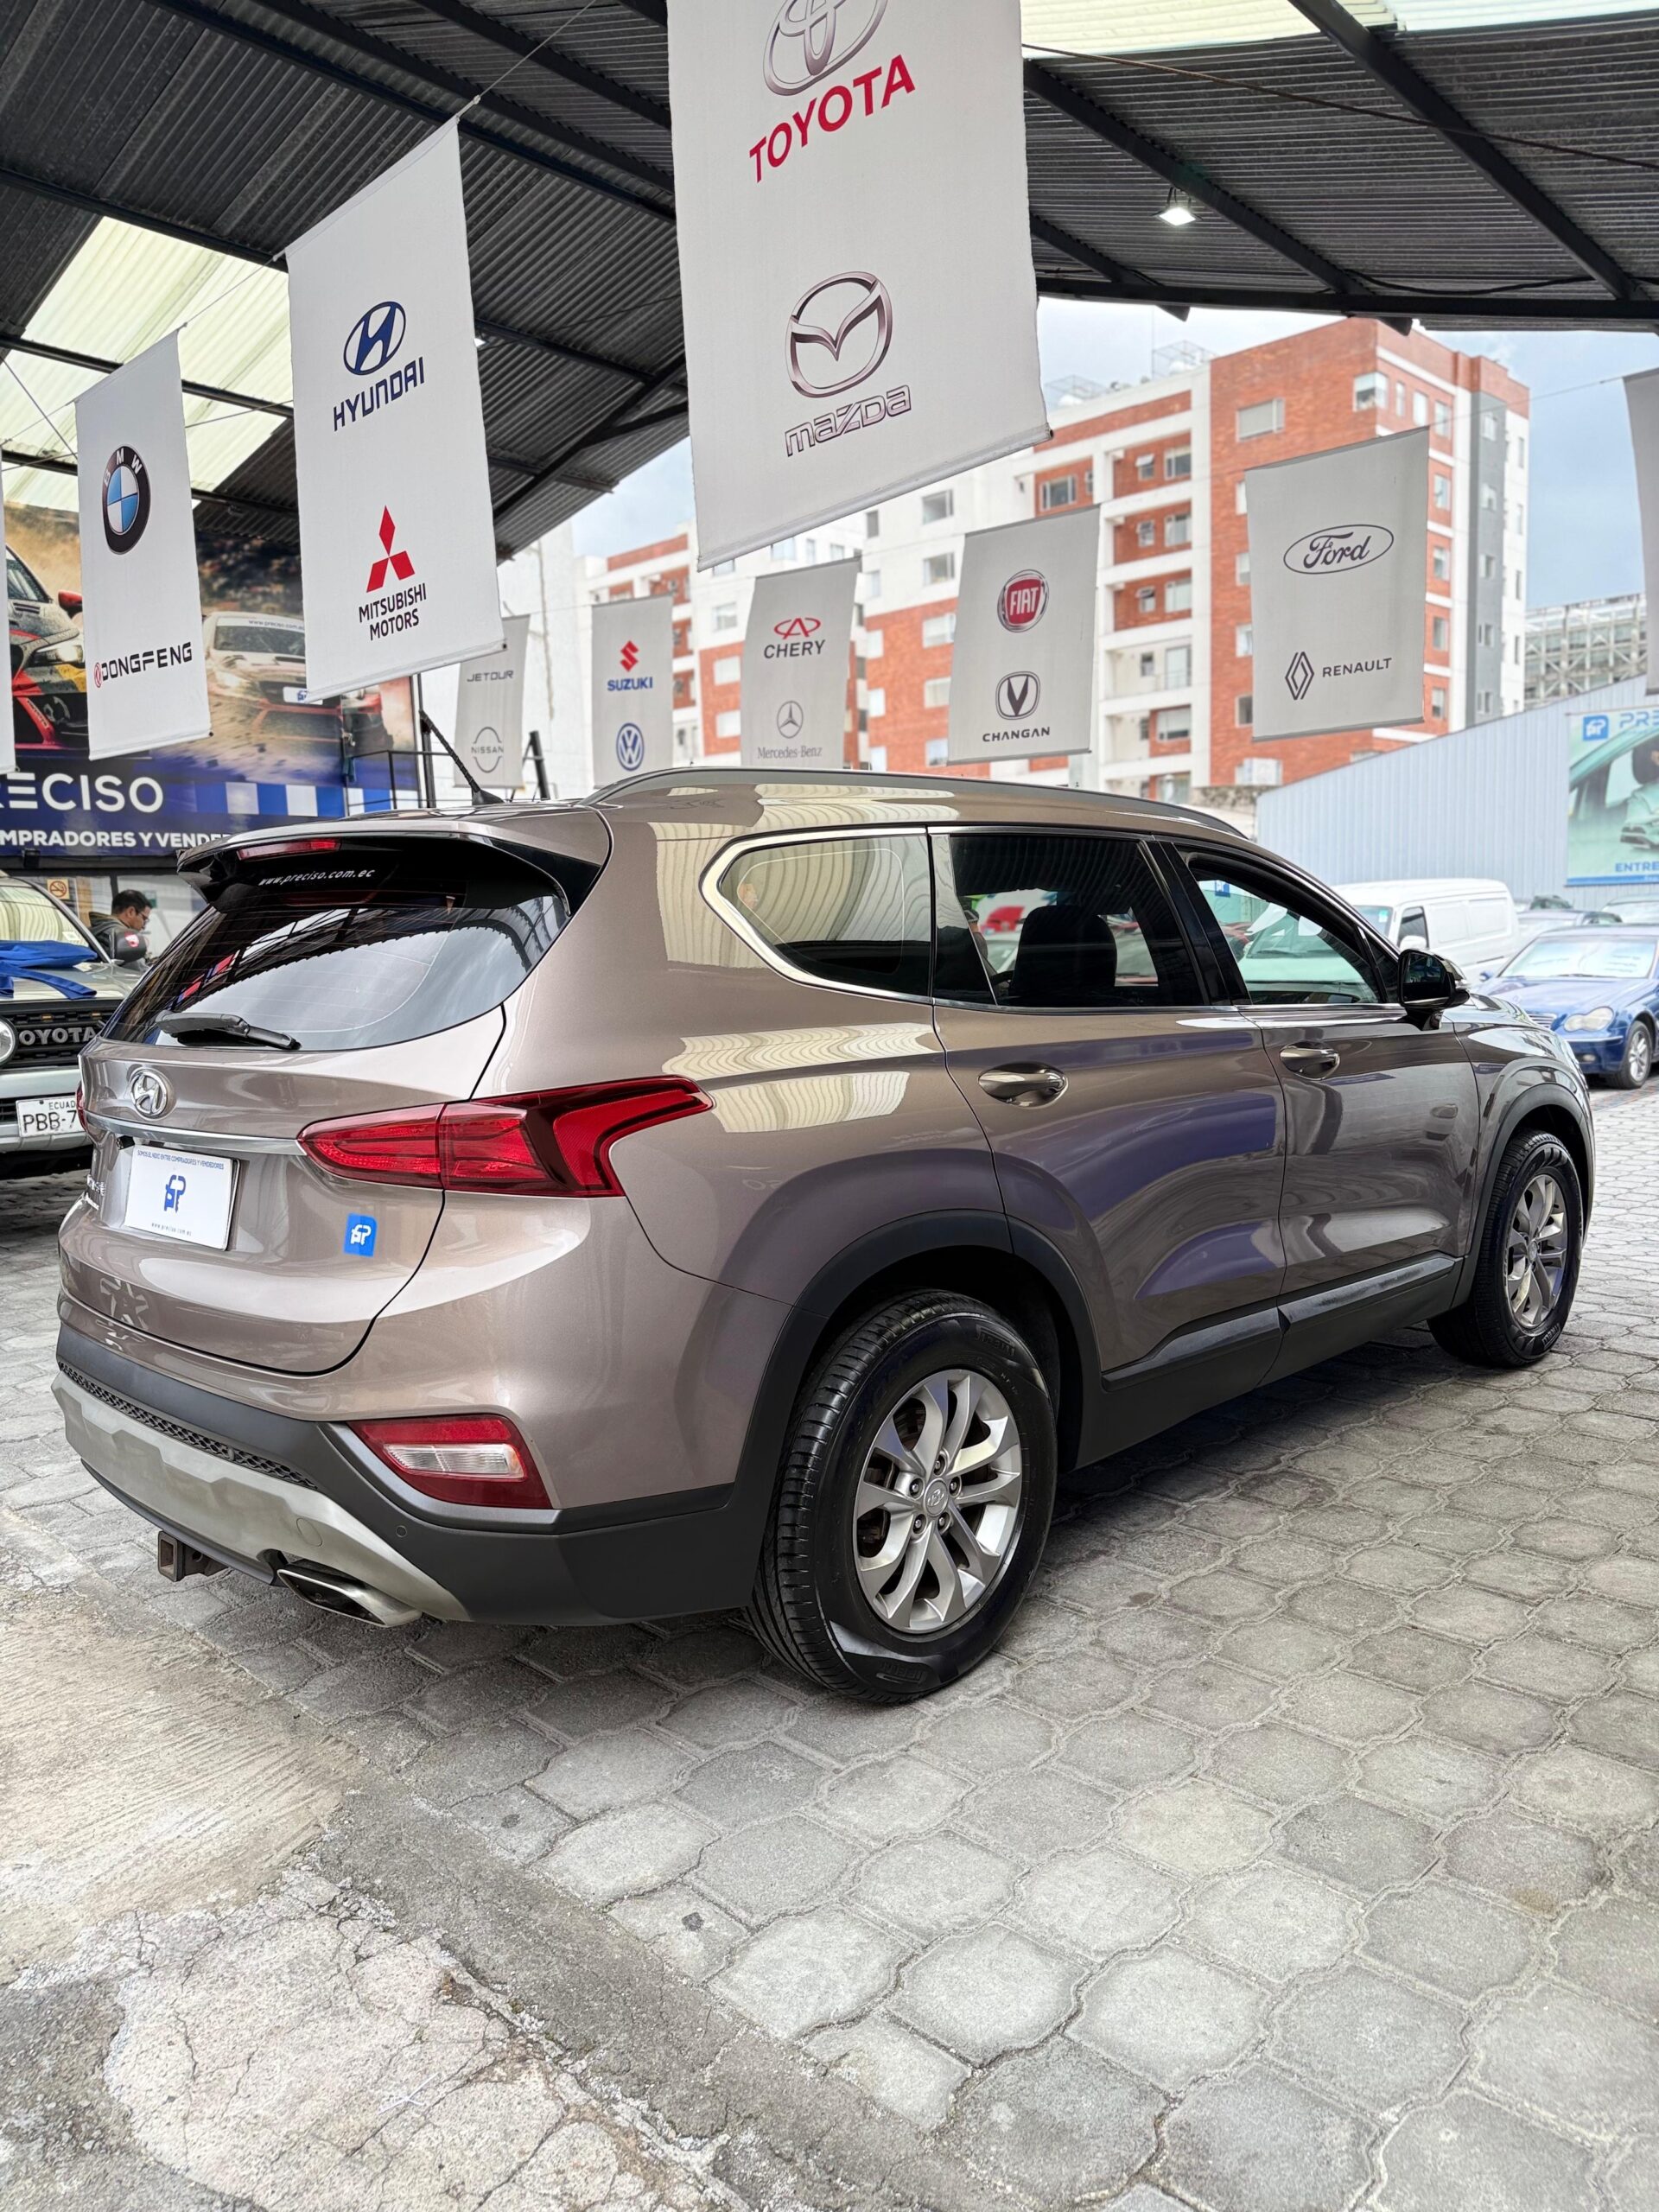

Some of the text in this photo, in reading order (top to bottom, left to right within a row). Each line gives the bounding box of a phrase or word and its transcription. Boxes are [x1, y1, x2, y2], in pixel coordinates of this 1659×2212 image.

[748, 54, 916, 183] TOYOTA
[333, 355, 425, 432] HYUNDAI
[1303, 531, 1372, 569] Ford
[358, 582, 427, 624] MITSUBISHI
[1008, 587, 1039, 616] FIAT
[369, 607, 420, 641] MOTORS
[763, 639, 826, 659] CHERY
[101, 641, 193, 681] DONGFENG
[1322, 657, 1392, 677] RENAULT
[467, 670, 514, 683] JETOUR
[607, 676, 653, 692] SUZUKI
[982, 726, 1051, 742] CHANGAN
[470, 746, 505, 754] NISSAN
[757, 745, 823, 760] Mercedes-Benz
[0, 772, 164, 814] ECISO
[138, 831, 154, 848] Y
[257, 868, 376, 887] www.preciso.com.ec
[19, 1026, 97, 1047] OYOTA
[48, 1100, 76, 1110] ECUAD
[22, 1109, 78, 1134] PBB-7
